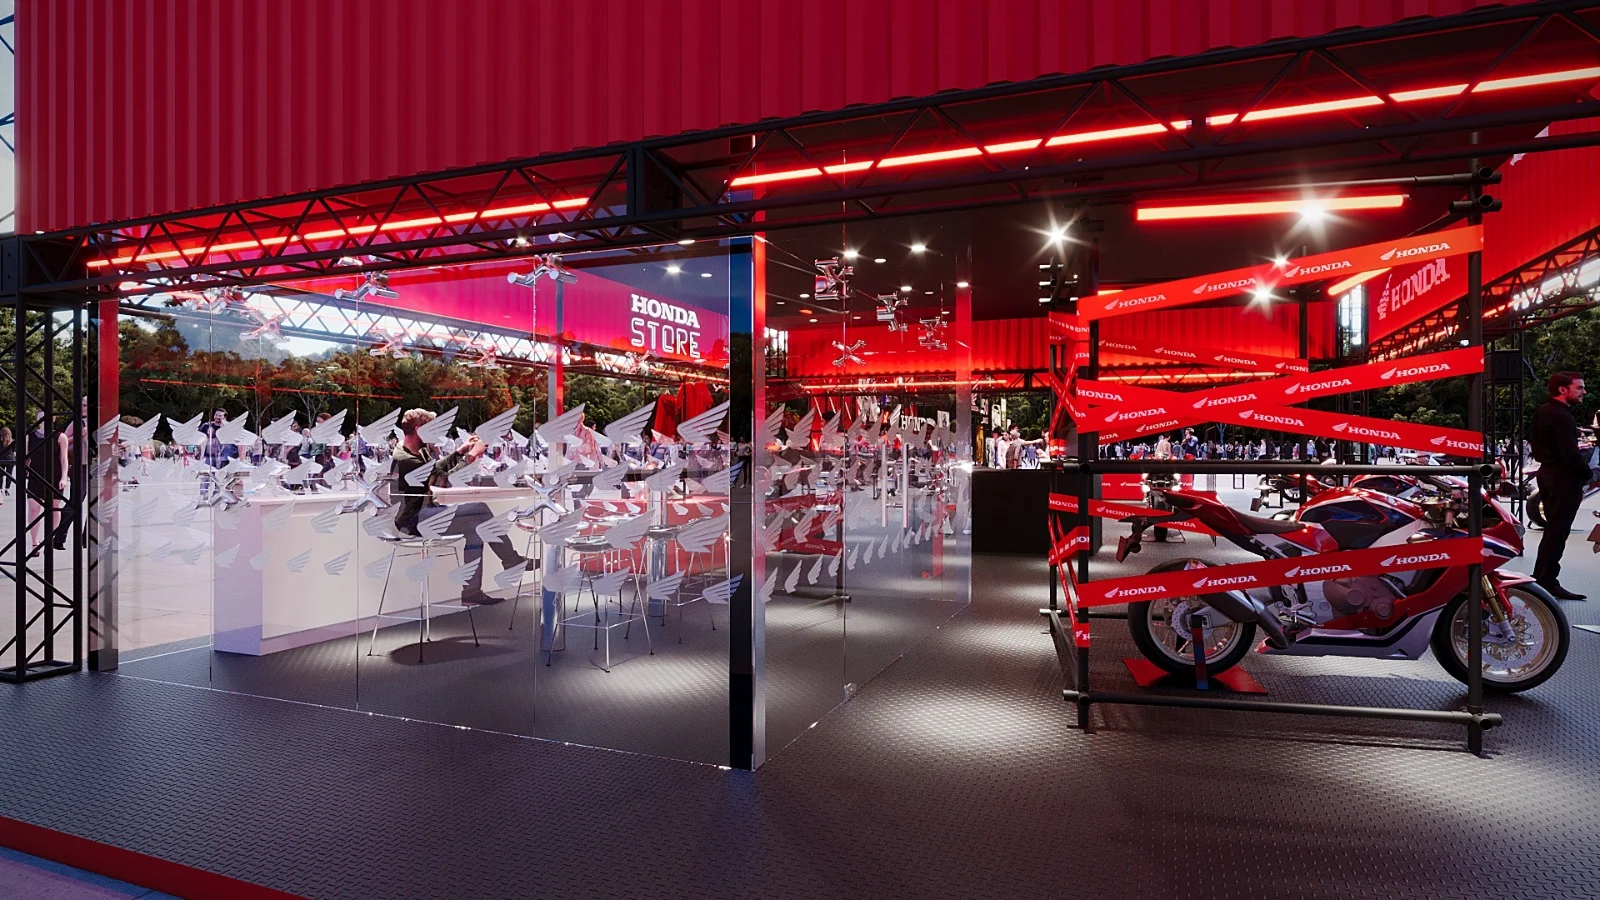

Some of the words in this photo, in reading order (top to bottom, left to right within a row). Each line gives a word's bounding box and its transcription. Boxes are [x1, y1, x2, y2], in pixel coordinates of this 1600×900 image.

[1119, 294, 1167, 308] HONDA
[1207, 277, 1257, 292] HONDA
[1300, 260, 1352, 276] HONDA
[1396, 242, 1450, 259] HONDA
[1391, 257, 1450, 312] HONDA
[631, 293, 700, 328] HONDA
[631, 317, 700, 358] STORE
[1105, 341, 1137, 350] HONDA
[1163, 349, 1196, 359] HONDA
[1223, 356, 1257, 366] HONDA
[1118, 407, 1167, 421] HONDA
[1207, 393, 1257, 406] HONDA
[1300, 378, 1352, 393] HONDA
[1396, 363, 1450, 378] HONDA
[1076, 389, 1123, 402] HONDA
[1254, 413, 1304, 427] HONDA
[1348, 426, 1401, 440] HONDA
[1145, 419, 1179, 431] HONDA
[1050, 499, 1079, 509] HONDA
[1119, 585, 1167, 597] HONDA
[1207, 575, 1257, 587] HONDA
[1300, 564, 1352, 577] HONDA
[1396, 552, 1450, 565] HONDA
